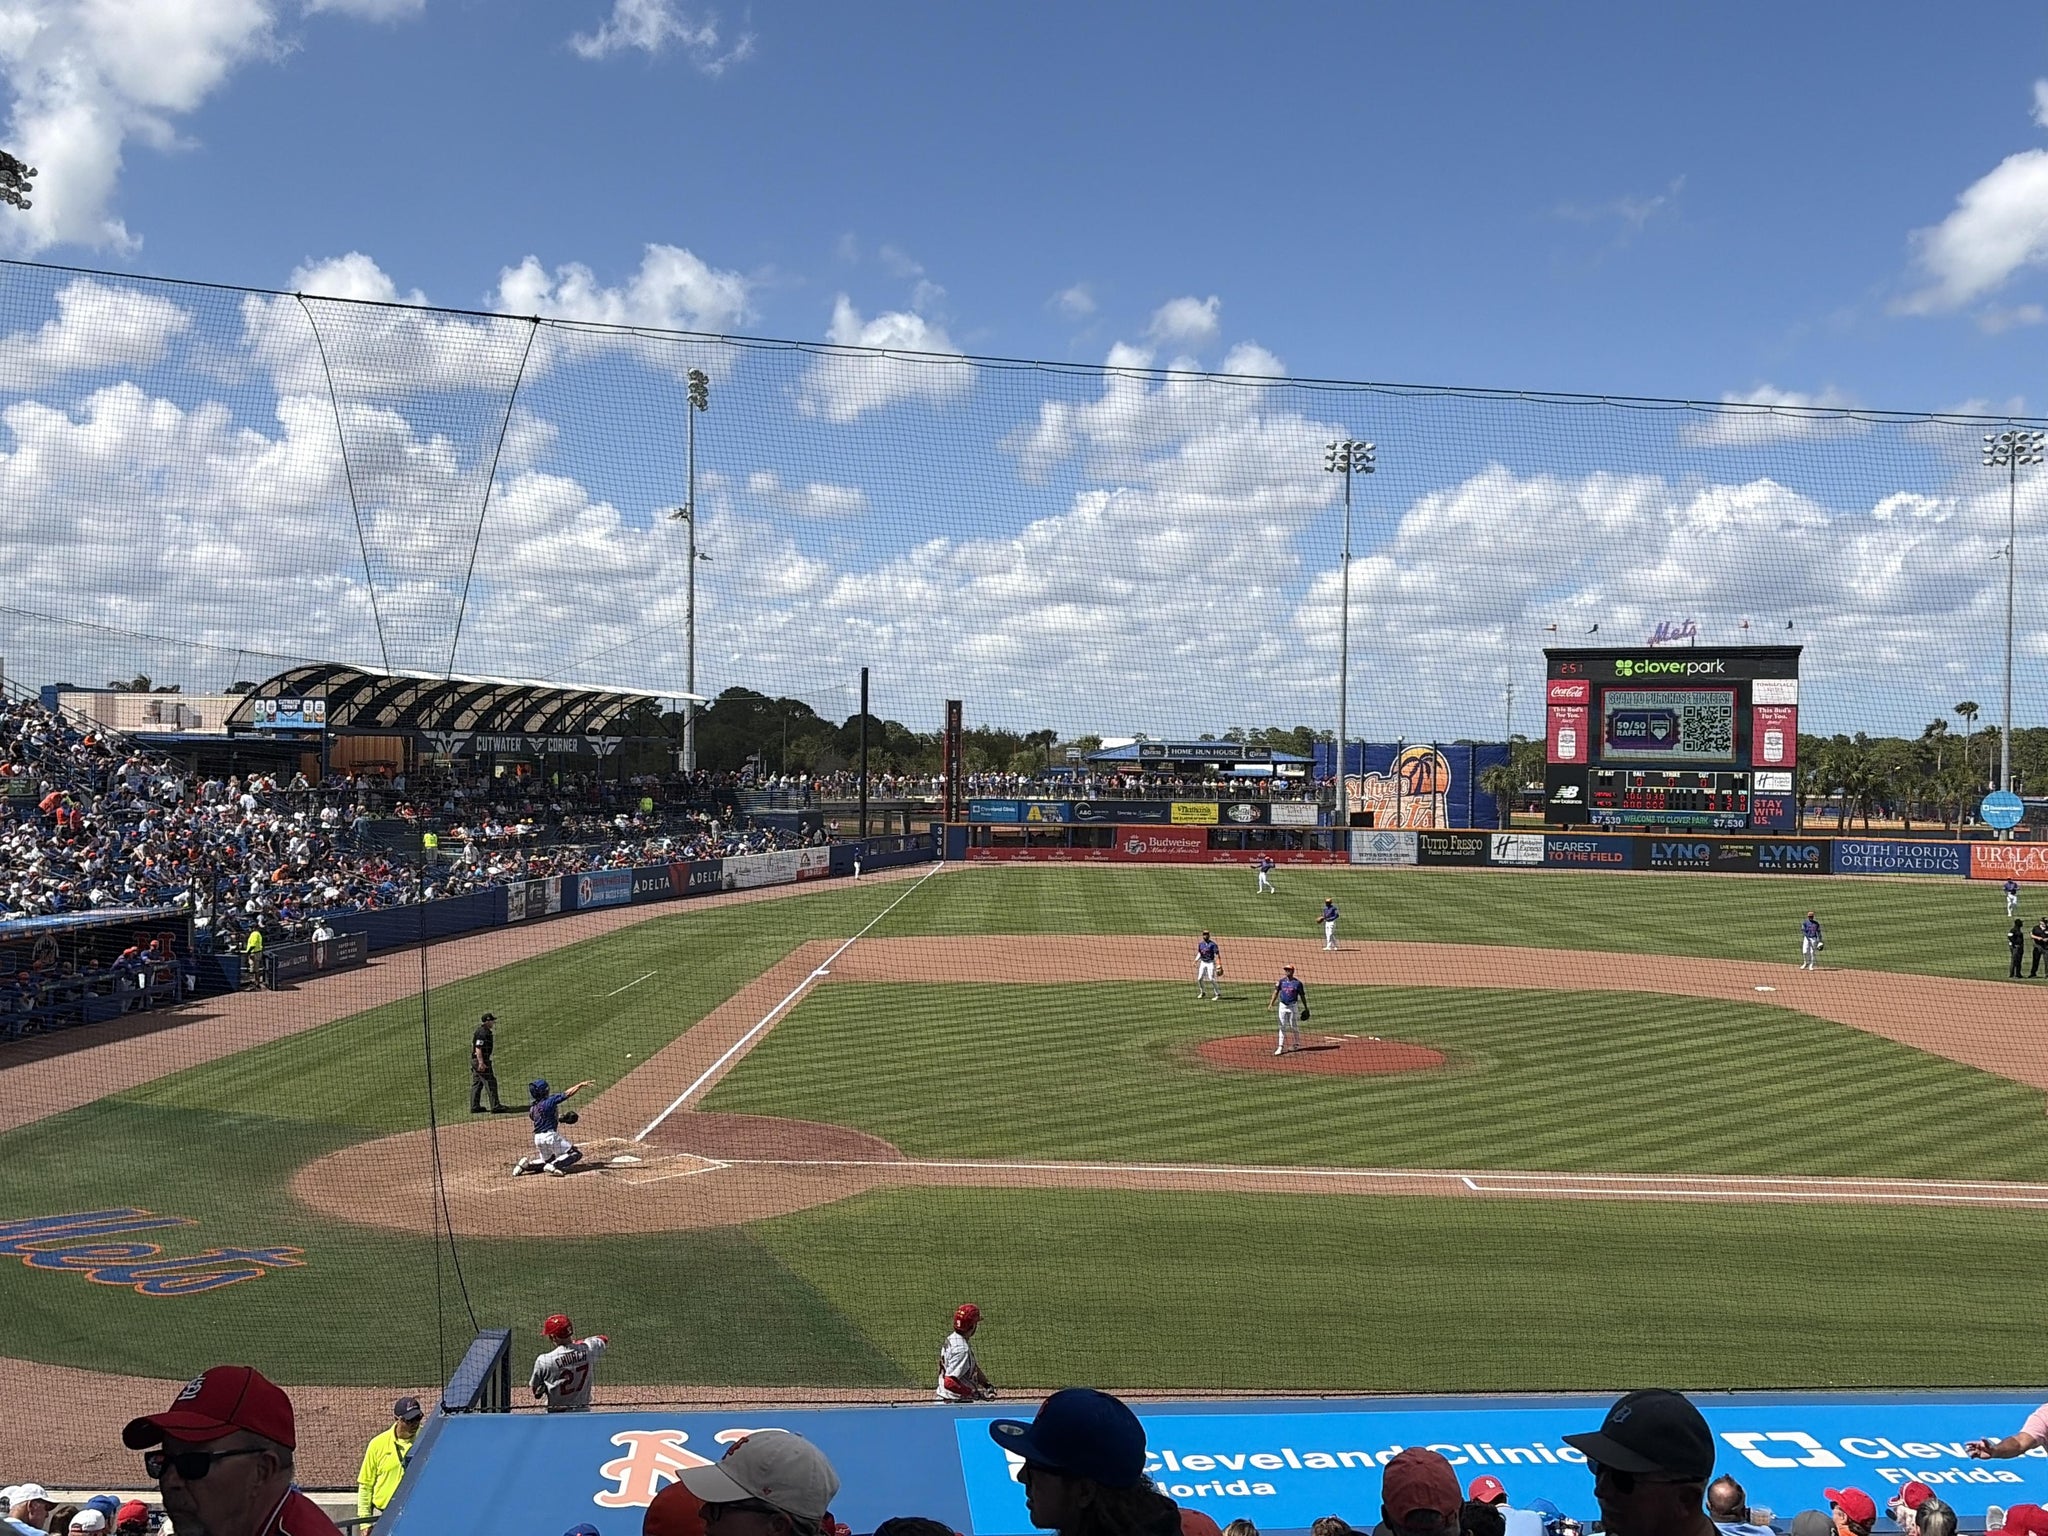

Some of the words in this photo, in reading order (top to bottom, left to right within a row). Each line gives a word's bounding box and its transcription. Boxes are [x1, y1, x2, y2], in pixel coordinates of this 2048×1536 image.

[1648, 618, 1697, 644] Mets
[1551, 686, 1584, 697] Coca-Cola
[1633, 692, 1644, 705] TO
[1617, 721, 1646, 730] 50/50
[476, 736, 522, 752] CUTWATER
[547, 738, 578, 753] CORNER
[1754, 800, 1782, 808] STAY
[1754, 808, 1783, 816] WITH
[1592, 816, 1621, 825] $7,530
[1624, 814, 1655, 823] WELCOME
[1666, 816, 1691, 824] CLOVER
[1714, 819, 1744, 828] $7,530
[1754, 816, 1771, 825] US.
[1149, 837, 1201, 847] Budweiser
[1420, 834, 1449, 850] TUTTO
[1450, 834, 1483, 850] FRESCO
[1549, 841, 1598, 852] NEAREST
[1549, 851, 1563, 861] TO
[1567, 852, 1588, 862] THE
[1590, 852, 1624, 863] FIELD
[1841, 843, 1890, 855] SOUTH
[1897, 845, 1959, 858] FLORIDA
[1841, 855, 1959, 870] ORTHOPAEDICS
[641, 876, 671, 892] DELTA
[697, 869, 721, 885] DELTA
[554, 1350, 588, 1368] CHURCH
[559, 1363, 589, 1396] 27
[1875, 1467, 2025, 1484] Florida
[1156, 1479, 1277, 1497] lorida
